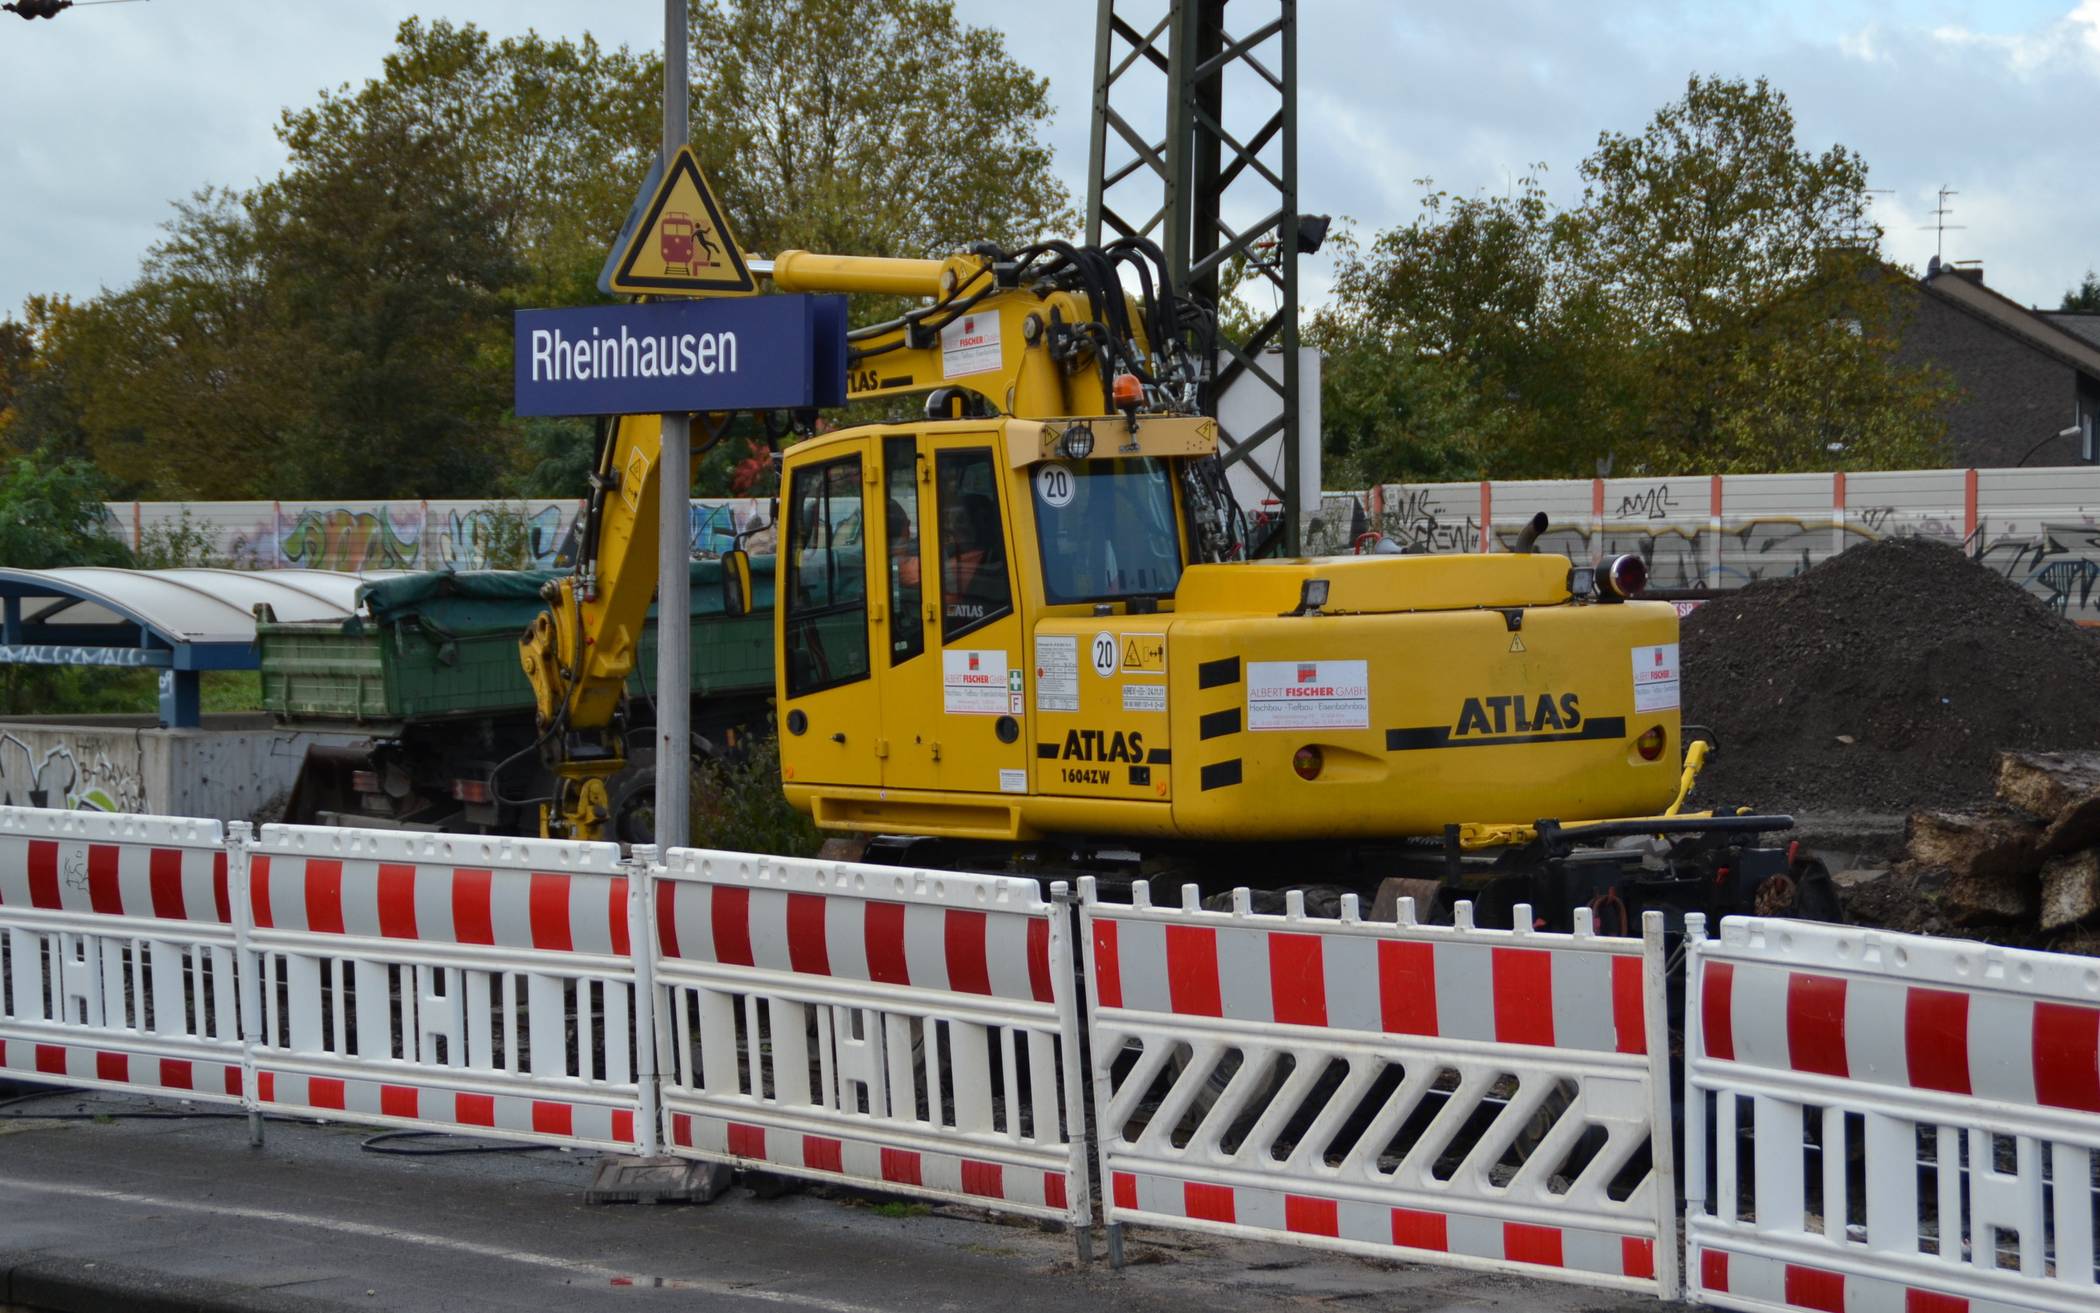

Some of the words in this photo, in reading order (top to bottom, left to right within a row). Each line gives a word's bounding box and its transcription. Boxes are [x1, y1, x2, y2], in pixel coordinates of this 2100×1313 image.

[960, 336, 984, 348] FISCHER
[532, 325, 737, 382] Rheinhausen
[848, 370, 878, 393] LAS
[1045, 471, 1067, 497] 20
[955, 604, 984, 617] ATLAS
[1097, 640, 1113, 668] 20
[963, 675, 989, 684] FISCHER
[1250, 687, 1283, 698] ALBERT
[1286, 687, 1335, 697] FISCHER
[1336, 686, 1367, 696] GMBH
[1013, 697, 1020, 711] F
[1250, 702, 1283, 713] Hochbau
[1287, 702, 1314, 712] Tiefbau
[1318, 701, 1367, 712] Eisenbahnbau
[1455, 692, 1581, 735] ATLAS
[1062, 729, 1143, 763] ATLAS
[1062, 768, 1110, 785] 1604ZW
